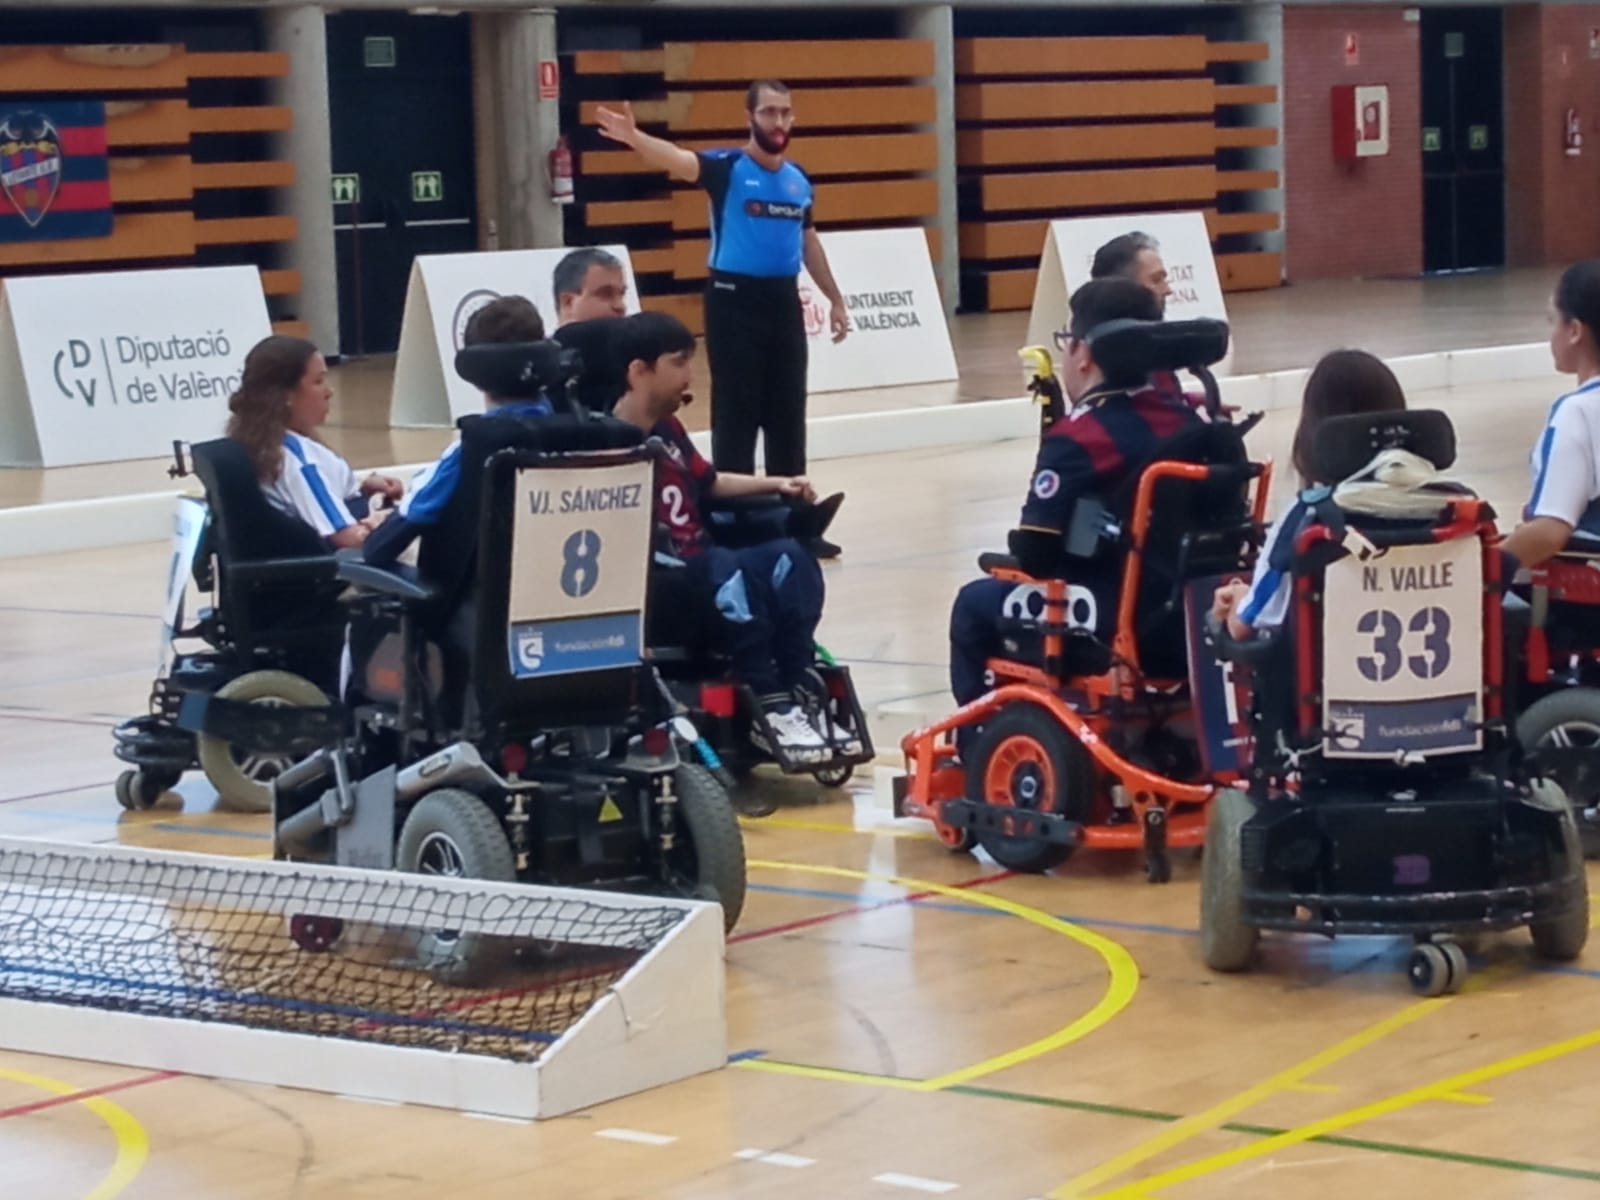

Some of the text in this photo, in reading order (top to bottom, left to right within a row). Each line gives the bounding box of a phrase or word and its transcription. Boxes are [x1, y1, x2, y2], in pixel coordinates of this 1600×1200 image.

[844, 289, 914, 309] UNTAMENT
[853, 309, 921, 331] VALÈNCIA
[117, 329, 230, 369] Diputació
[126, 368, 245, 405] de Valènc
[559, 483, 642, 513] SÁNCHEZ
[560, 529, 602, 598] 8
[1363, 562, 1453, 592] N. VALLE
[1356, 606, 1452, 682] 33
